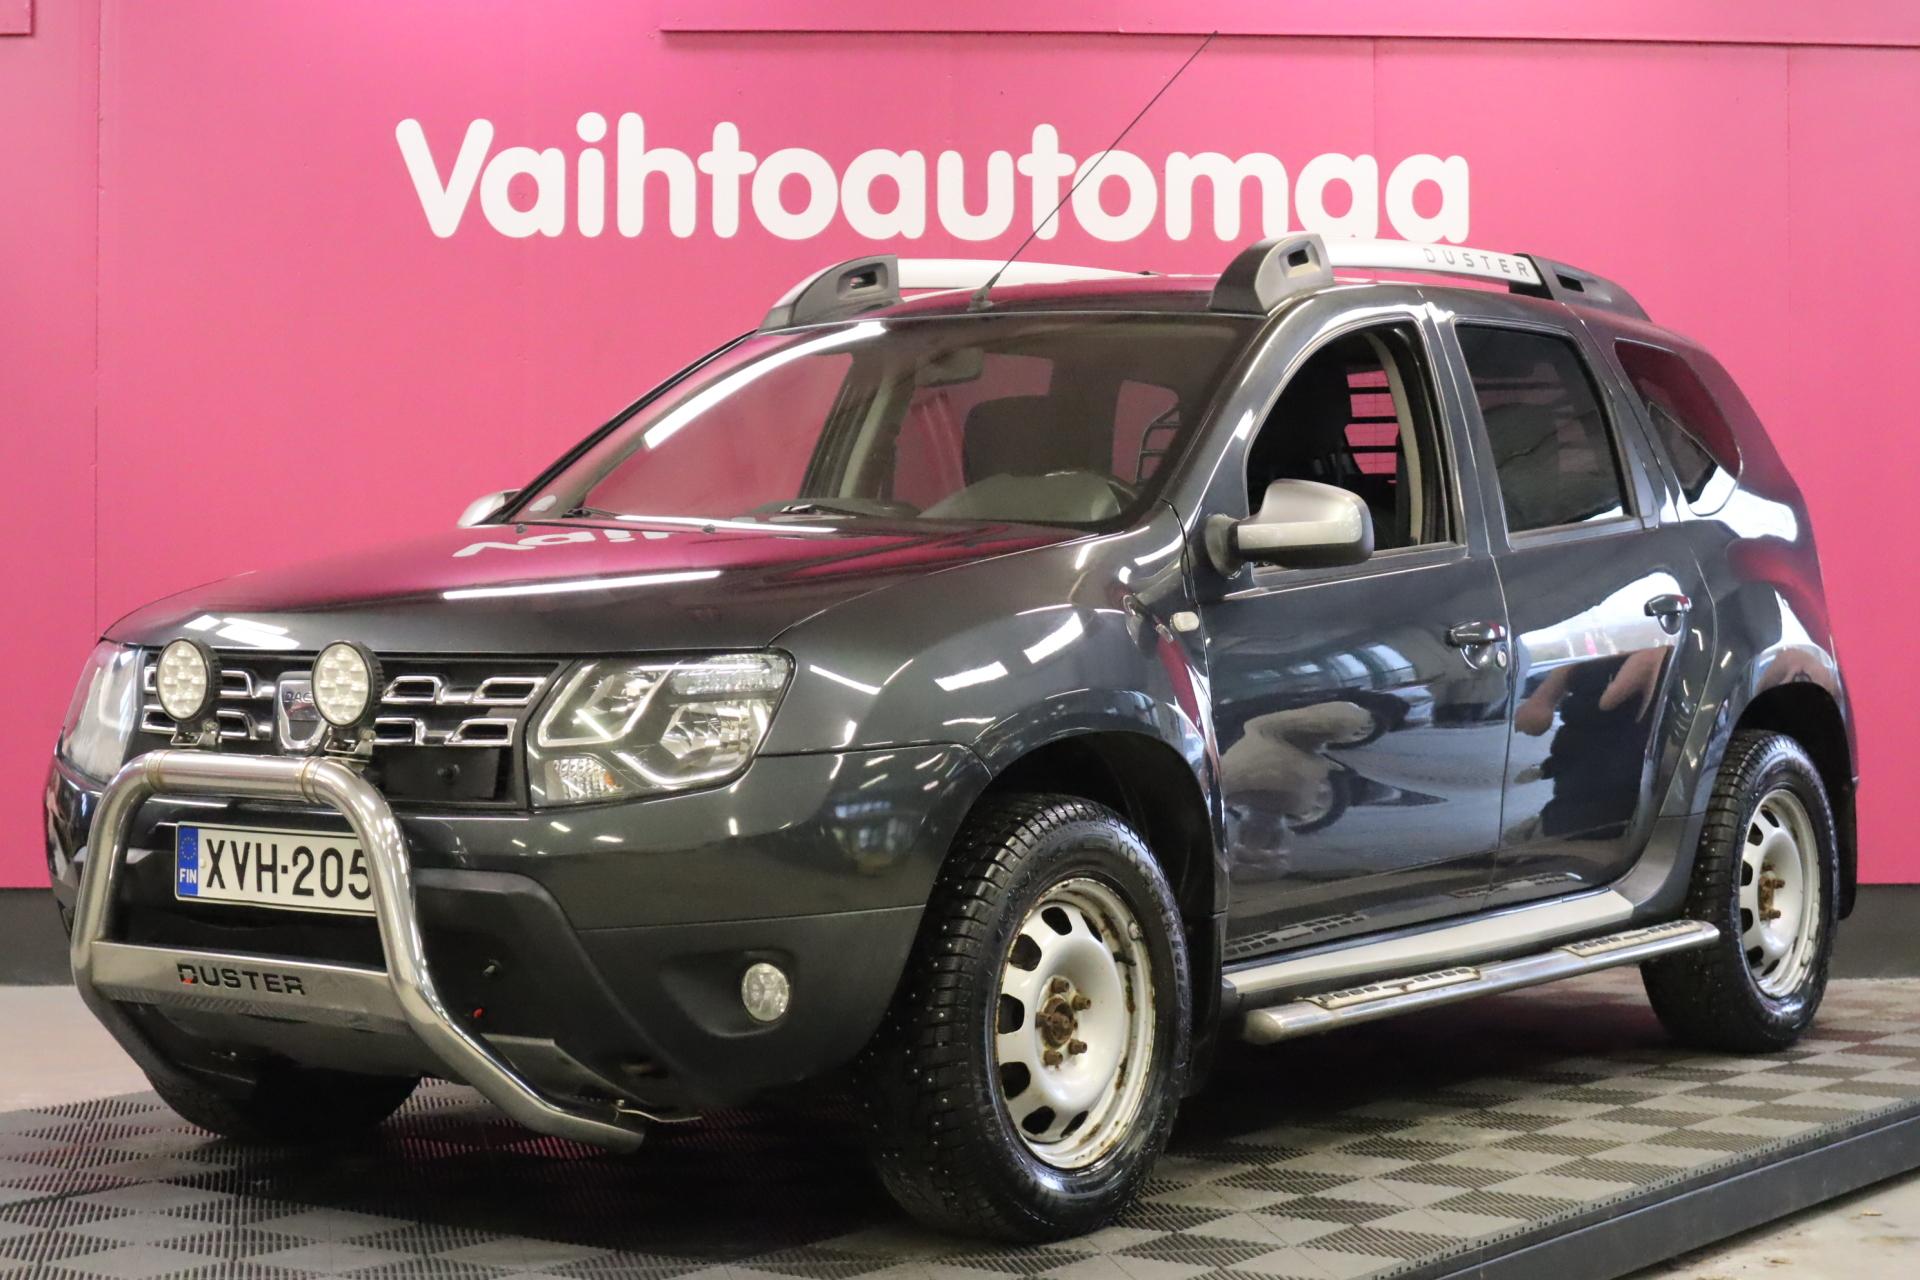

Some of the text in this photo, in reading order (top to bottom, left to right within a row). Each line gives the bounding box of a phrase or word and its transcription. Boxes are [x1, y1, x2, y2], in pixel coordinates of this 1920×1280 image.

[395, 111, 1470, 243] Vaihtoautomaa
[1422, 246, 1531, 278] DUSTER
[179, 867, 197, 884] FIN
[176, 963, 307, 996] DUSTER
